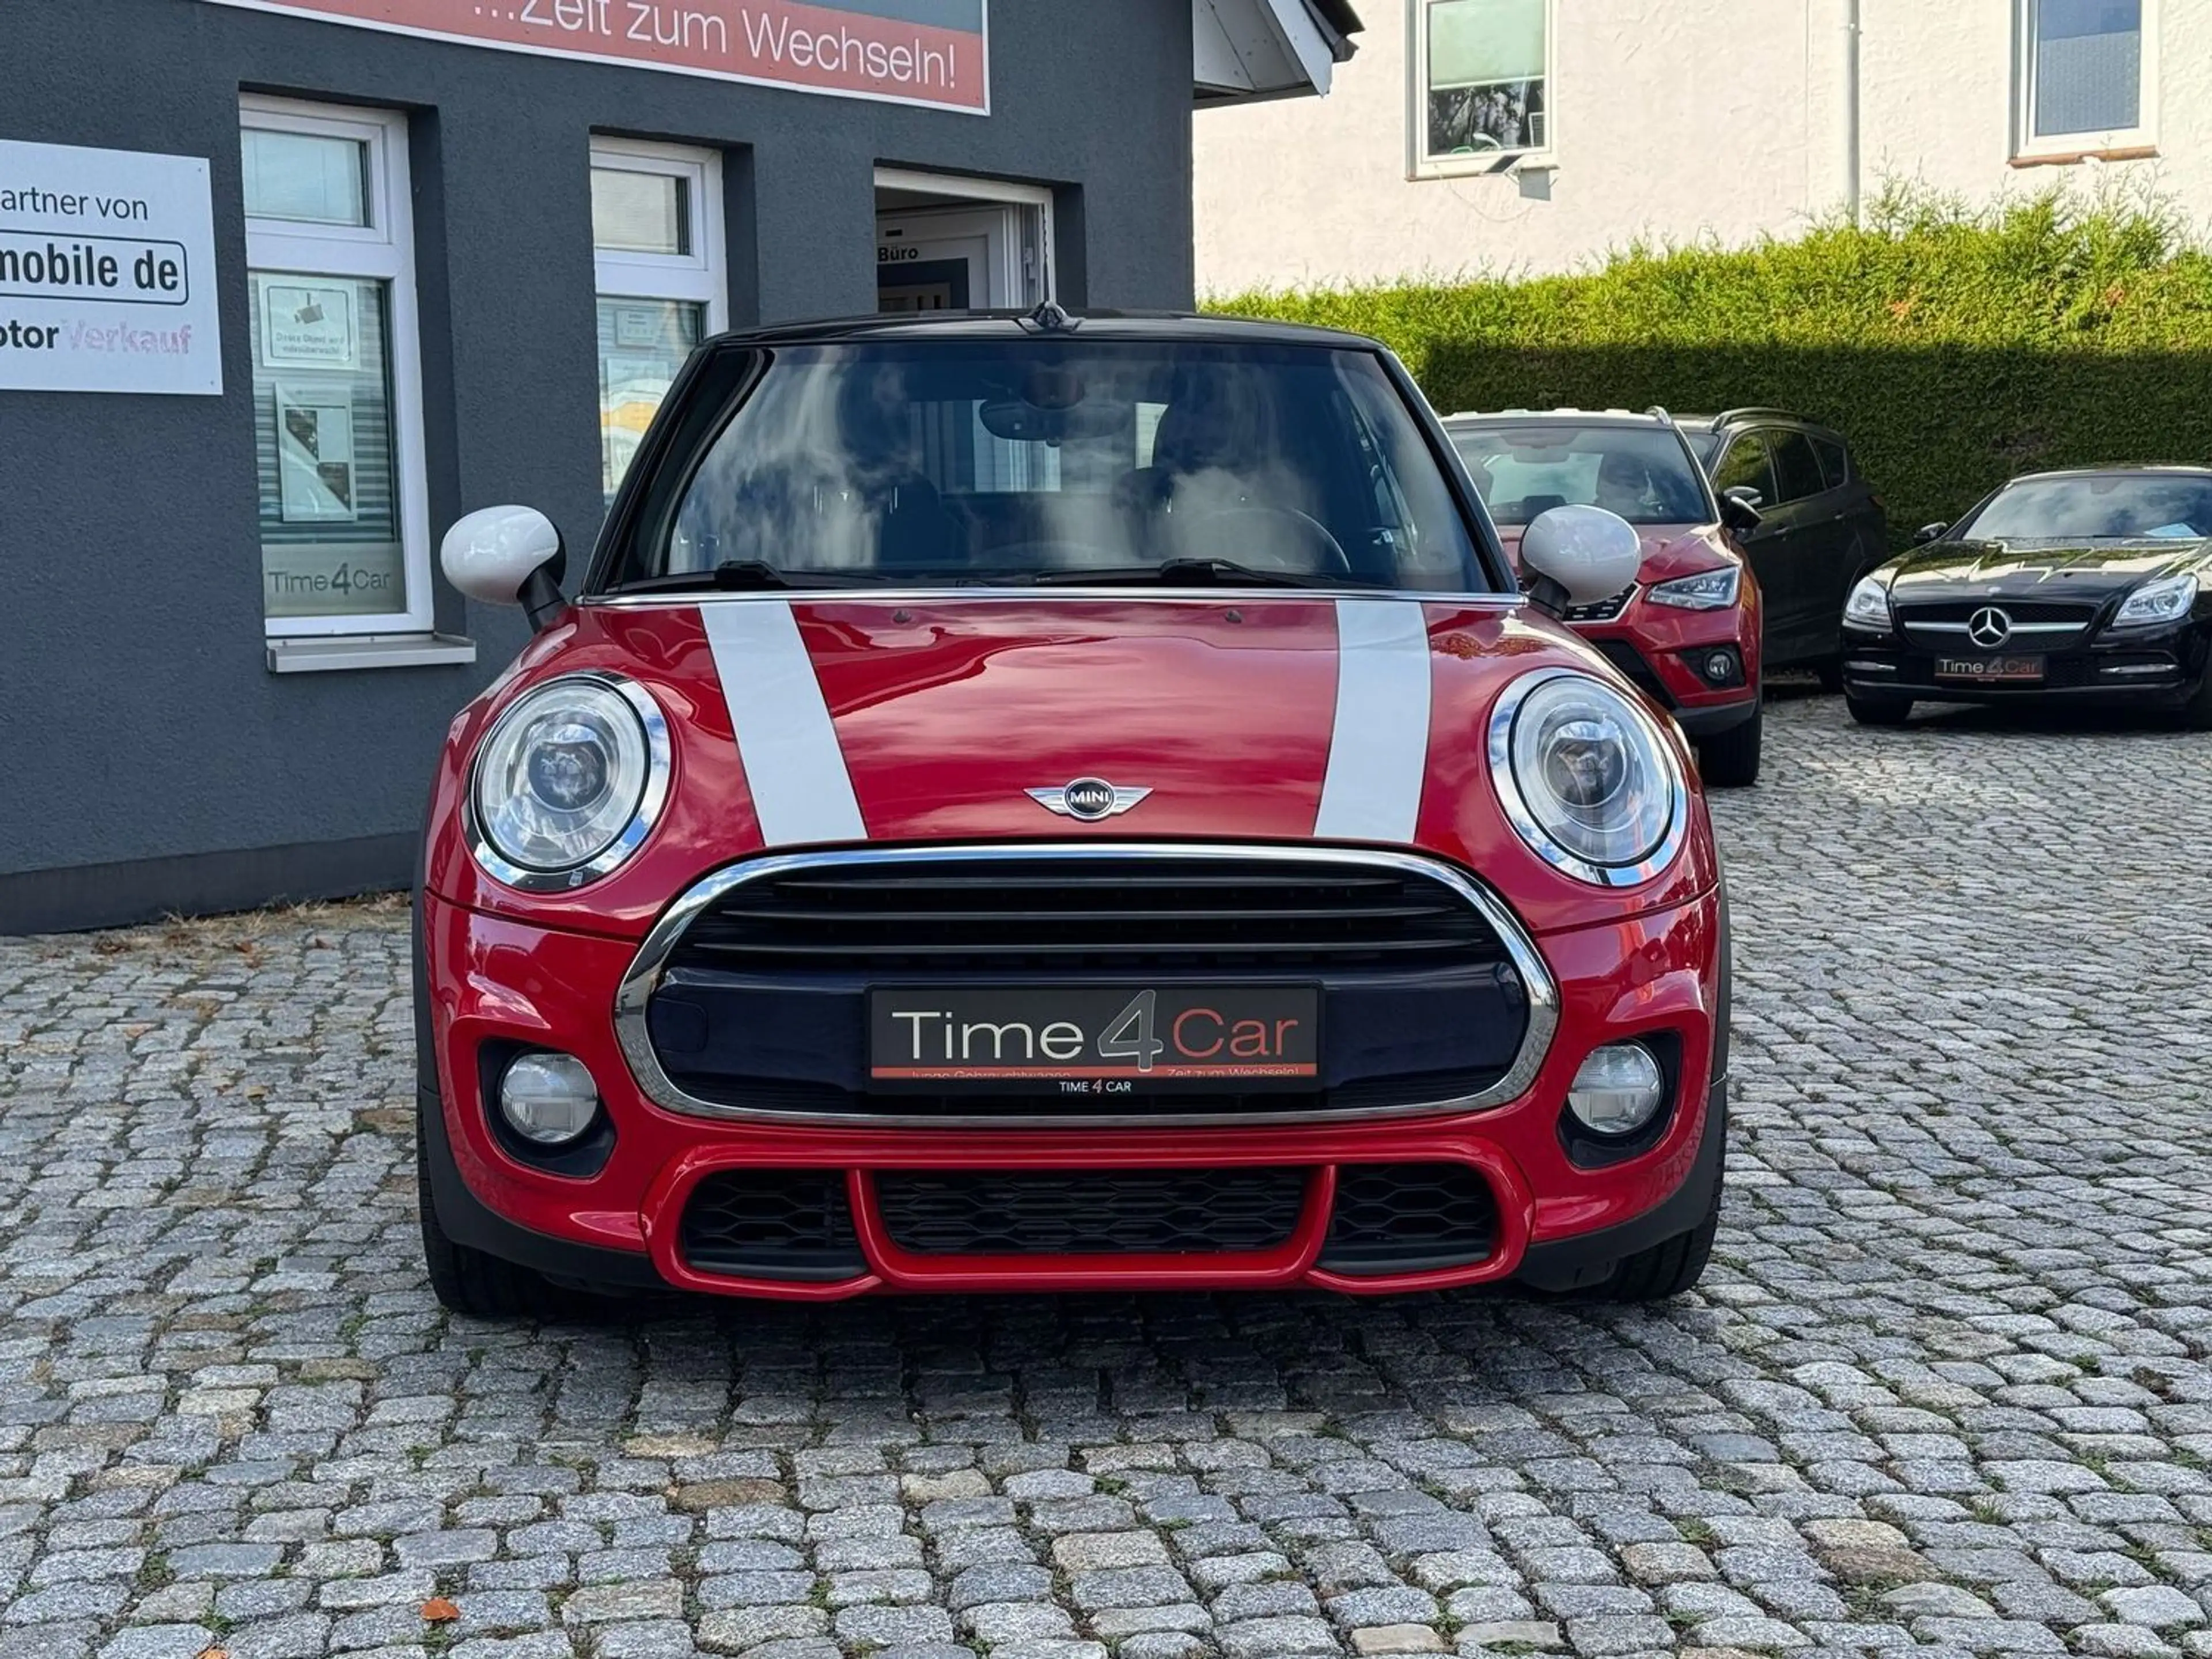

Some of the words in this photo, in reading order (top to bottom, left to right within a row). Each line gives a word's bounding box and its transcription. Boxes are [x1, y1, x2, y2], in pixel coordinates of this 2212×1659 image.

[626, 2, 727, 53] zum
[742, 9, 956, 88] Wechseln!
[96, 197, 149, 221] von
[878, 245, 919, 262] Büro
[134, 249, 179, 291] de
[1070, 790, 1109, 803] MINI
[892, 1011, 1084, 1060] Time
[1173, 1008, 1298, 1058] Car
[1059, 1081, 1089, 1092] TIME
[1092, 1079, 1103, 1093] 4
[1106, 1081, 1131, 1092] CAR
